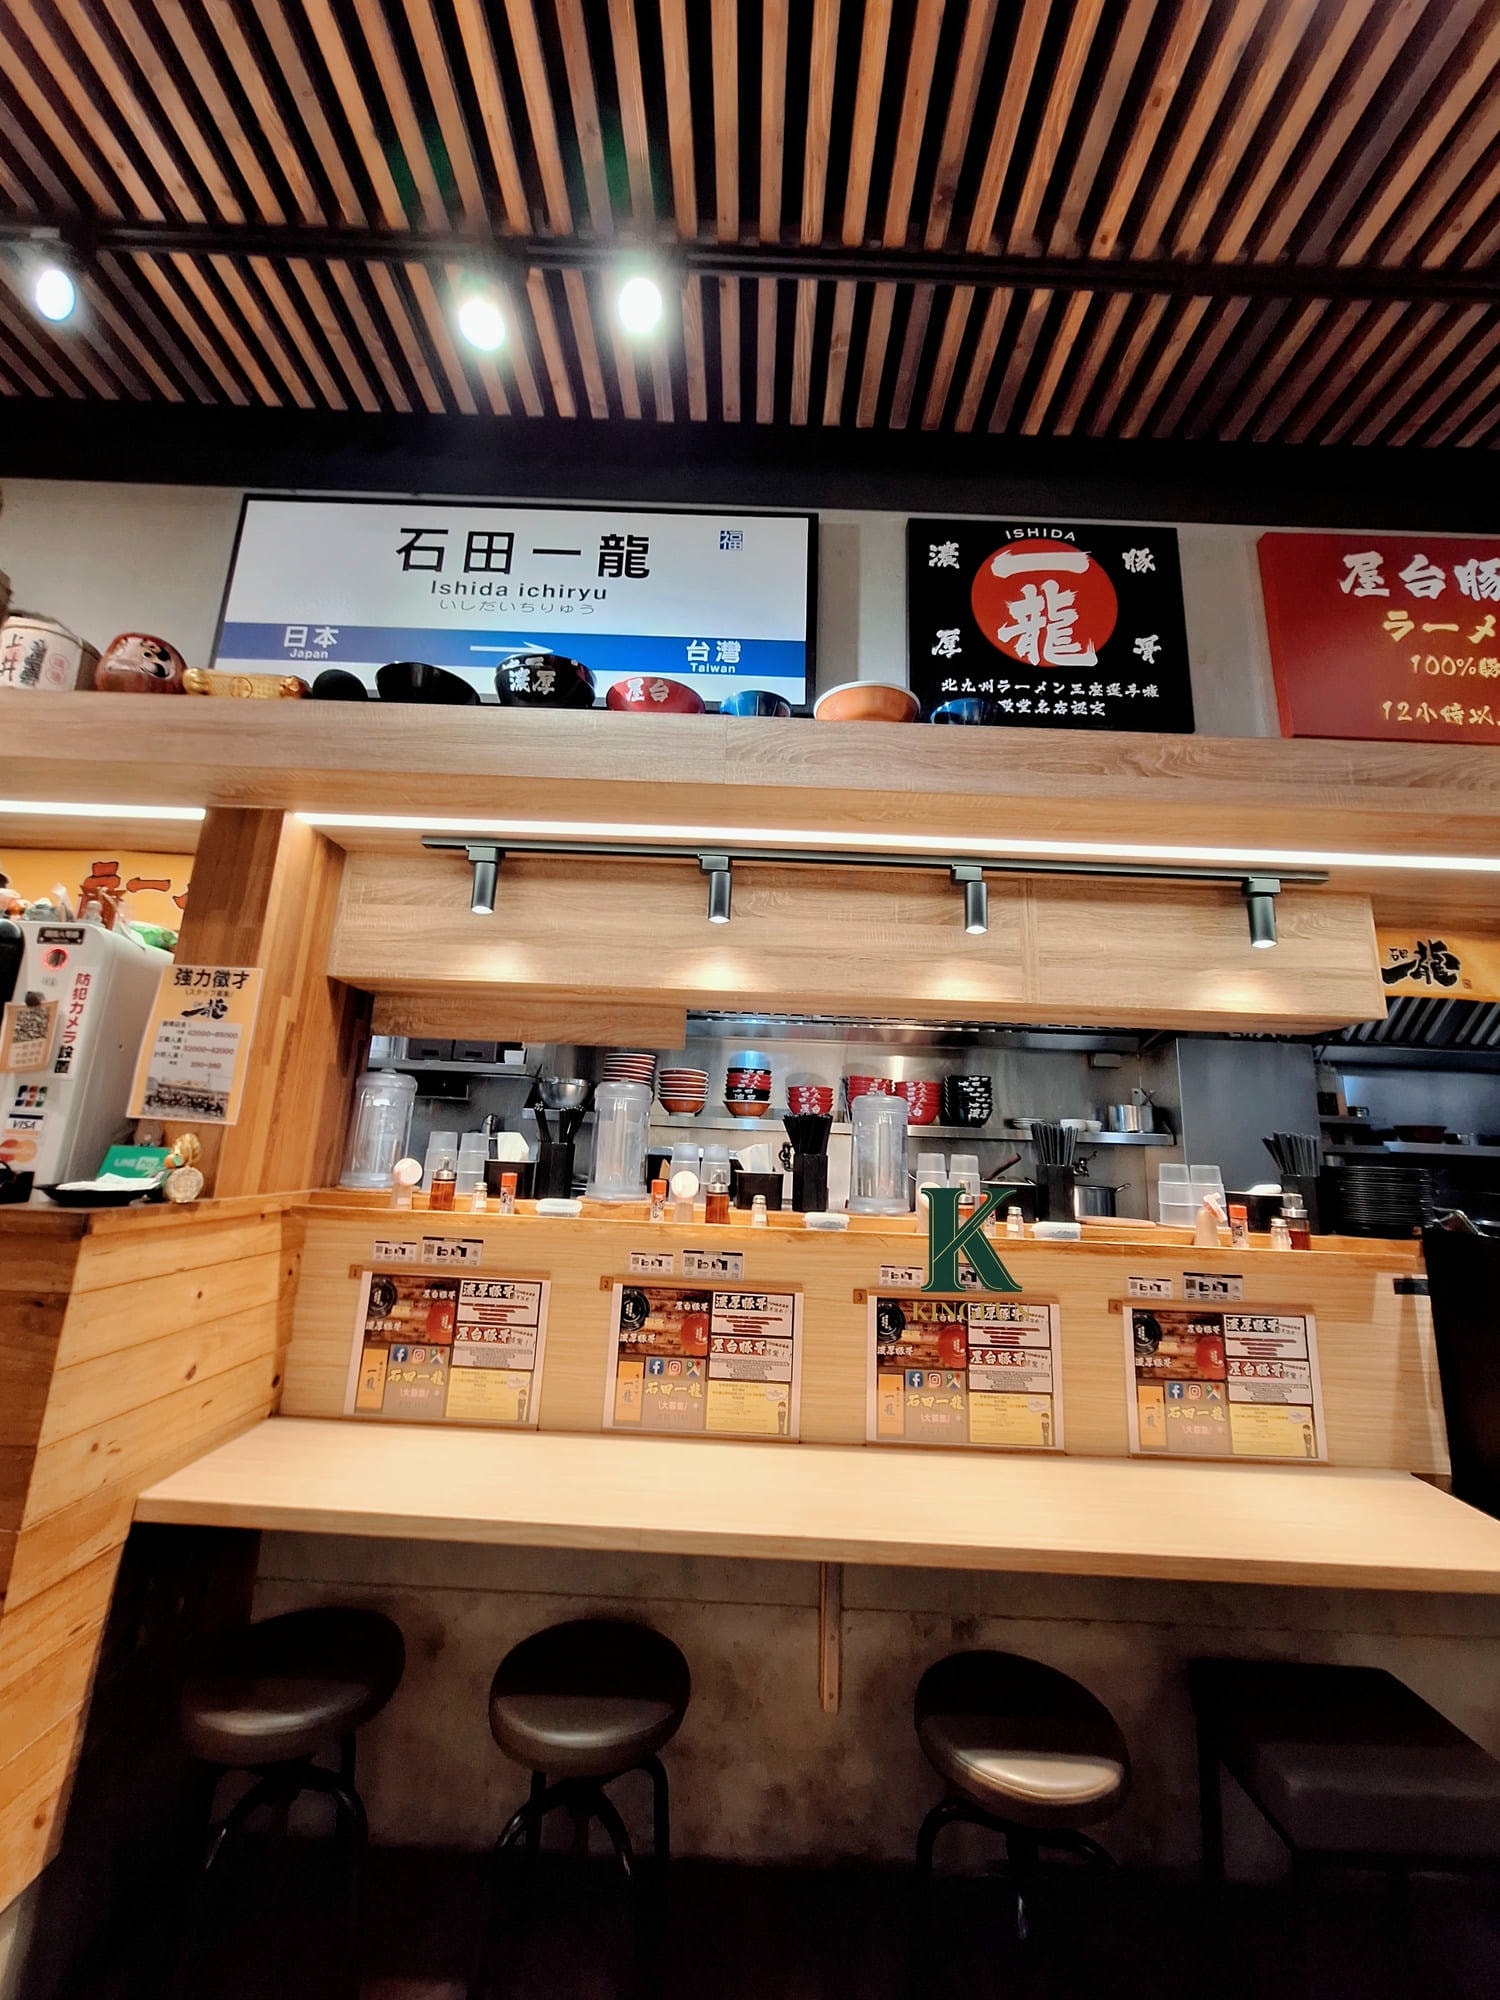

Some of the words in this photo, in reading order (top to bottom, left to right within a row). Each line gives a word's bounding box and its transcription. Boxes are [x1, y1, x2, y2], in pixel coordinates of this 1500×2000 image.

[719, 530, 744, 551] 福
[1005, 528, 1077, 542] ISHIDA
[395, 526, 652, 579] 石田一龍
[928, 541, 960, 569] 濃
[1122, 548, 1156, 573] 豚
[431, 580, 509, 598] Ishida
[519, 582, 608, 603] ichiryu
[437, 598, 595, 615] いしだいちりゅう
[990, 549, 1098, 667] 一龍
[283, 626, 340, 649] 日本
[931, 629, 963, 658] 厚
[289, 648, 329, 661] Japan
[686, 639, 742, 664] 台灣
[690, 662, 737, 674] Taiwan
[508, 668, 557, 696] 濃厚
[12, 1119, 37, 1130] VISA
